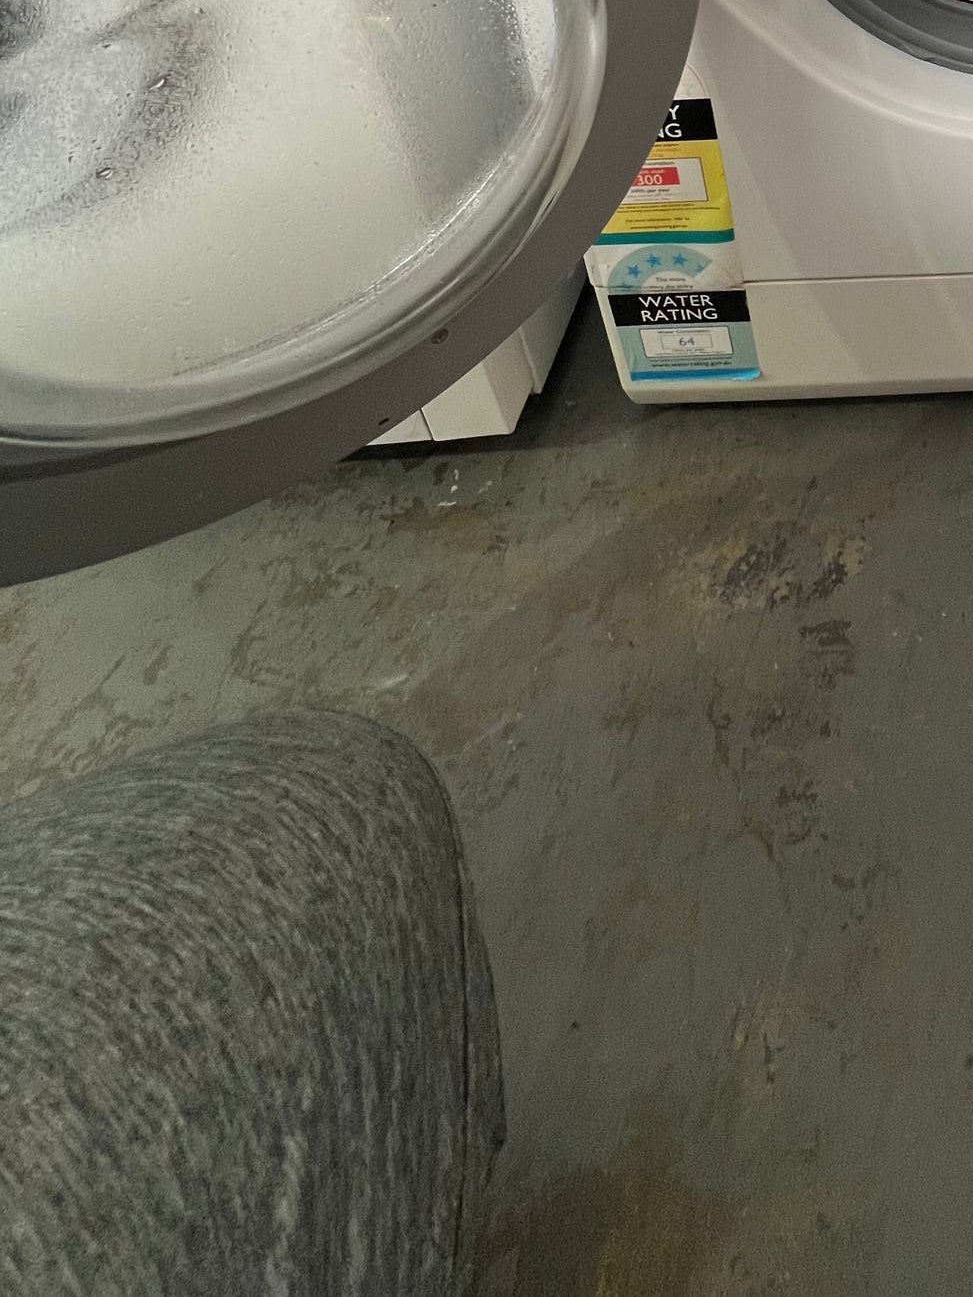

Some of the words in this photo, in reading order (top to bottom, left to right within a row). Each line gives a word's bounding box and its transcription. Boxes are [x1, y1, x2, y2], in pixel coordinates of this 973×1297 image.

[637, 174, 662, 186] 300
[638, 295, 714, 308] WATER
[641, 308, 718, 322] RATING
[679, 337, 694, 347] 64
